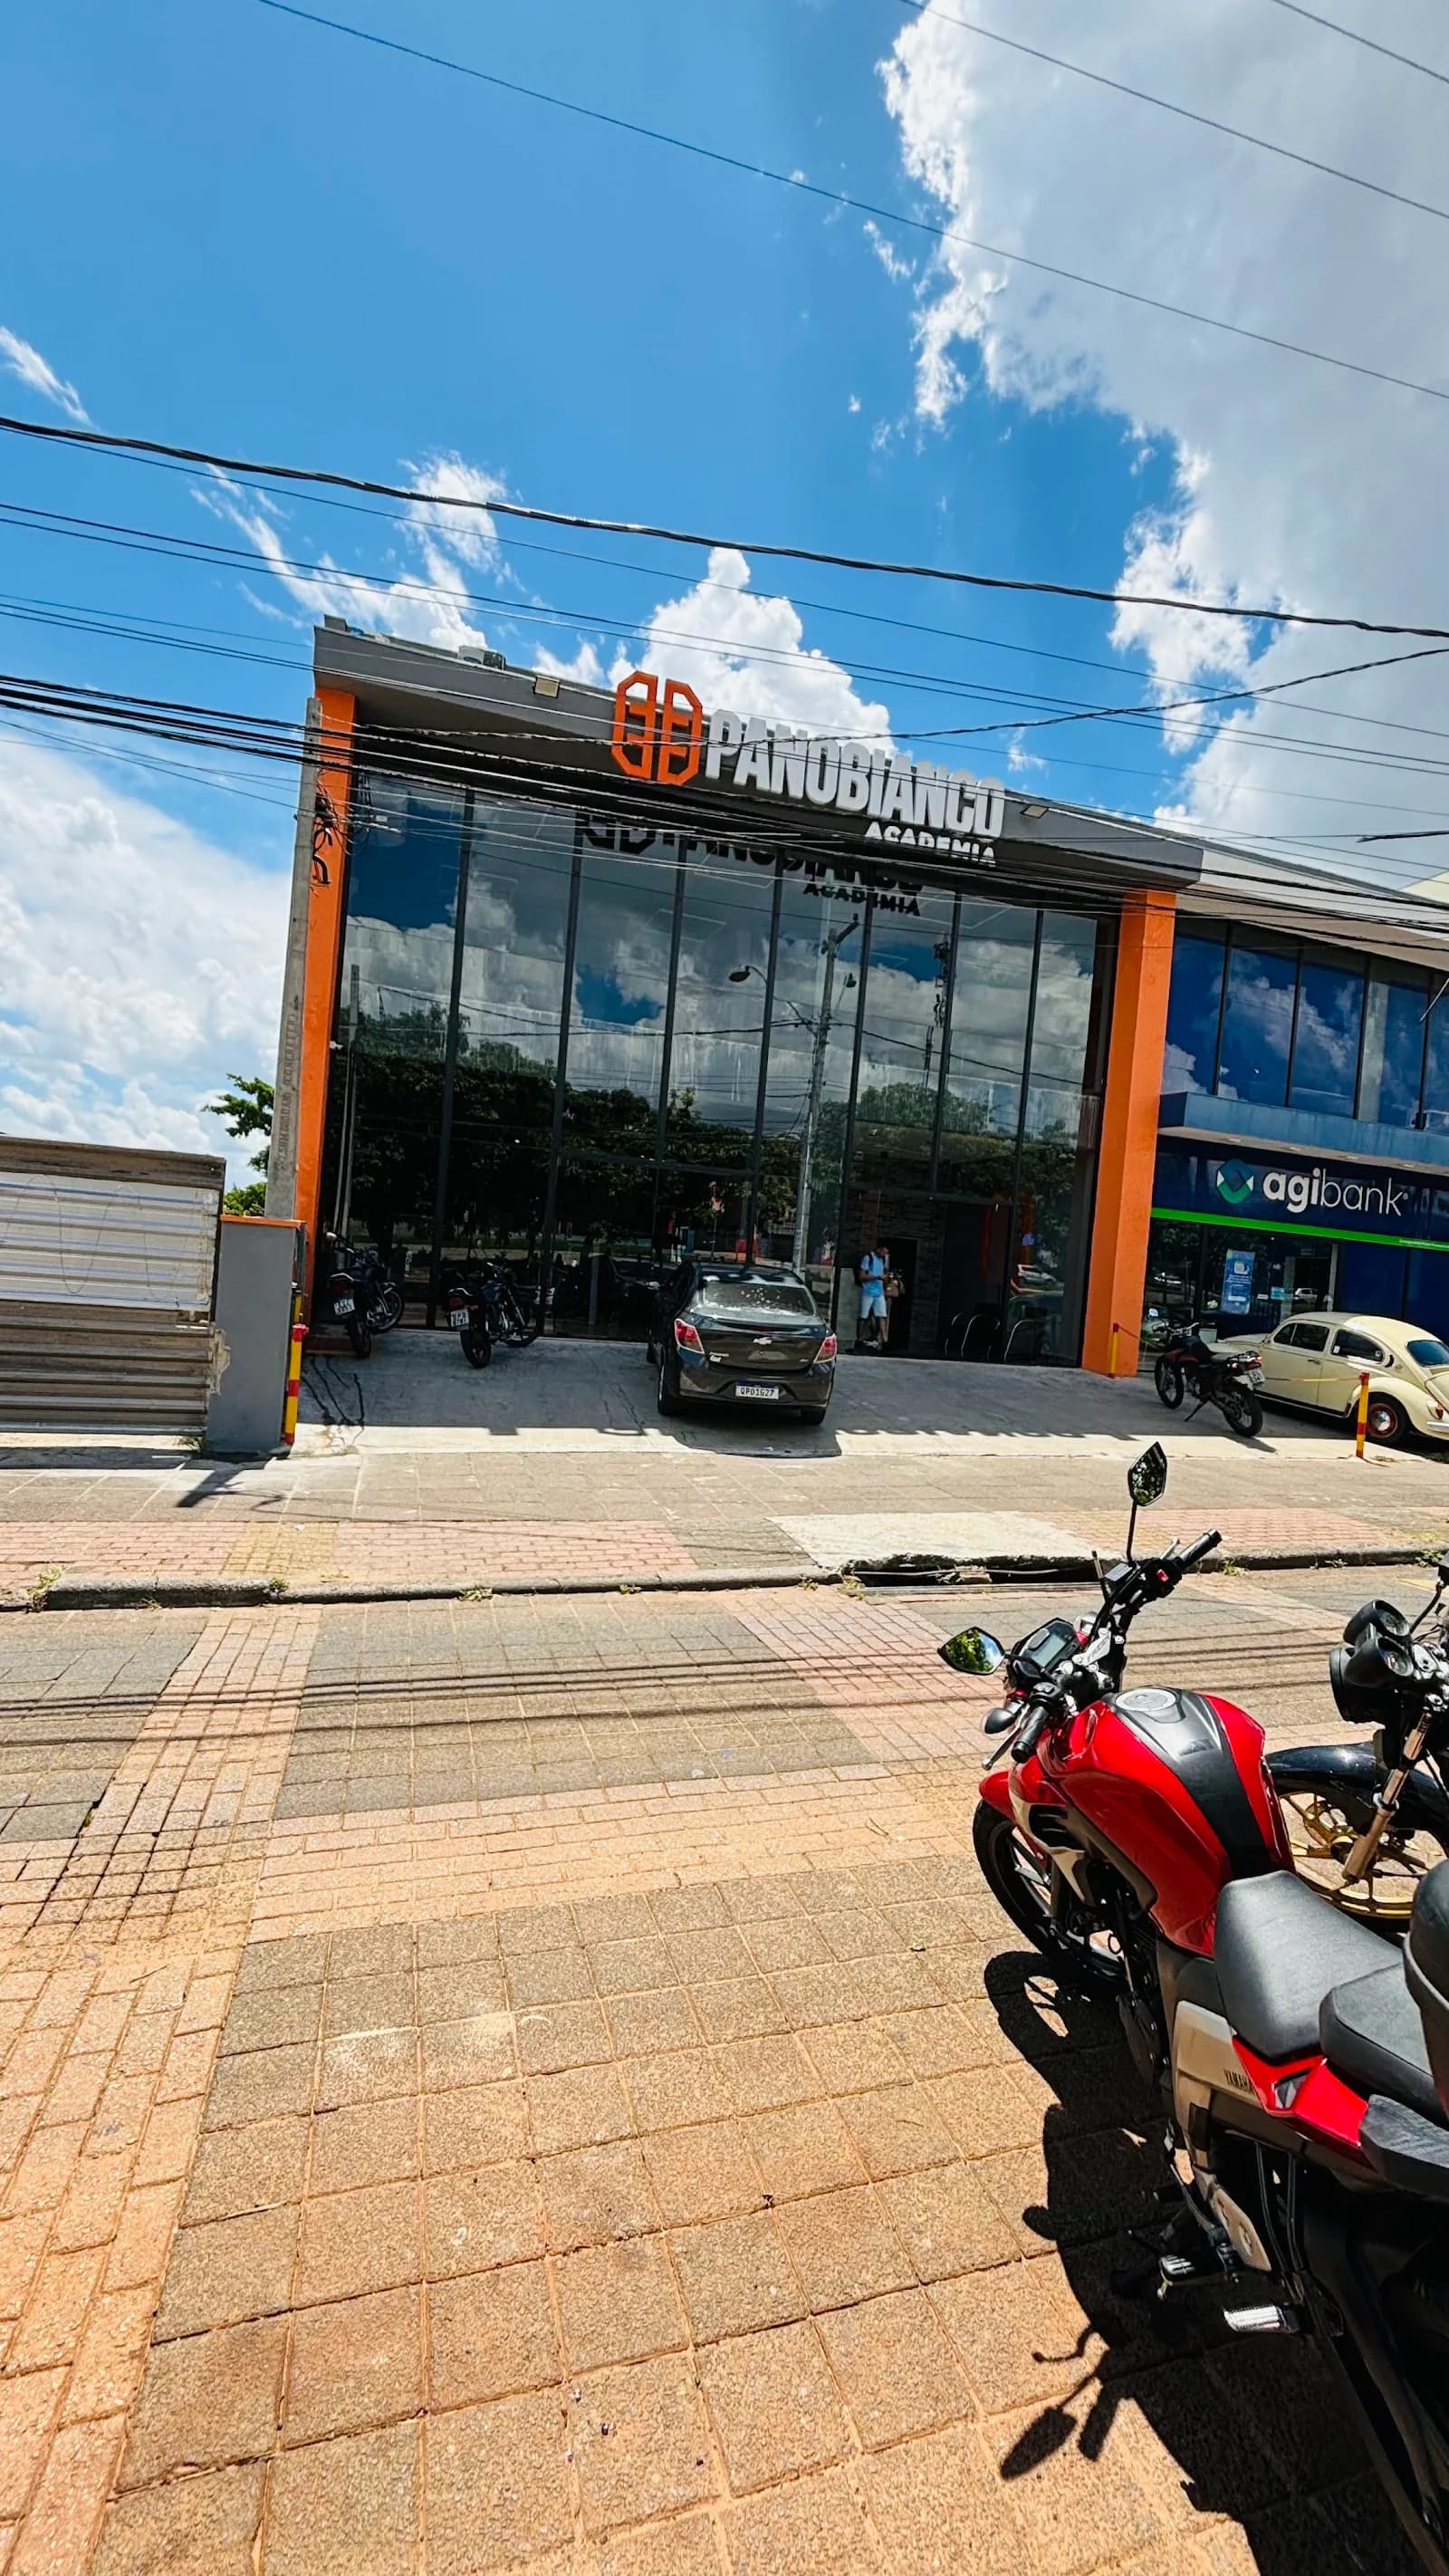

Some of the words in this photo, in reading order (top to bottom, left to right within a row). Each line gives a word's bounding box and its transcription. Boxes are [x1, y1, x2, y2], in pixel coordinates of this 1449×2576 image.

[705, 708, 1006, 839] PANOBIANCO
[864, 821, 997, 869] ACADEMIA
[1262, 1167, 1403, 1216] agibank
